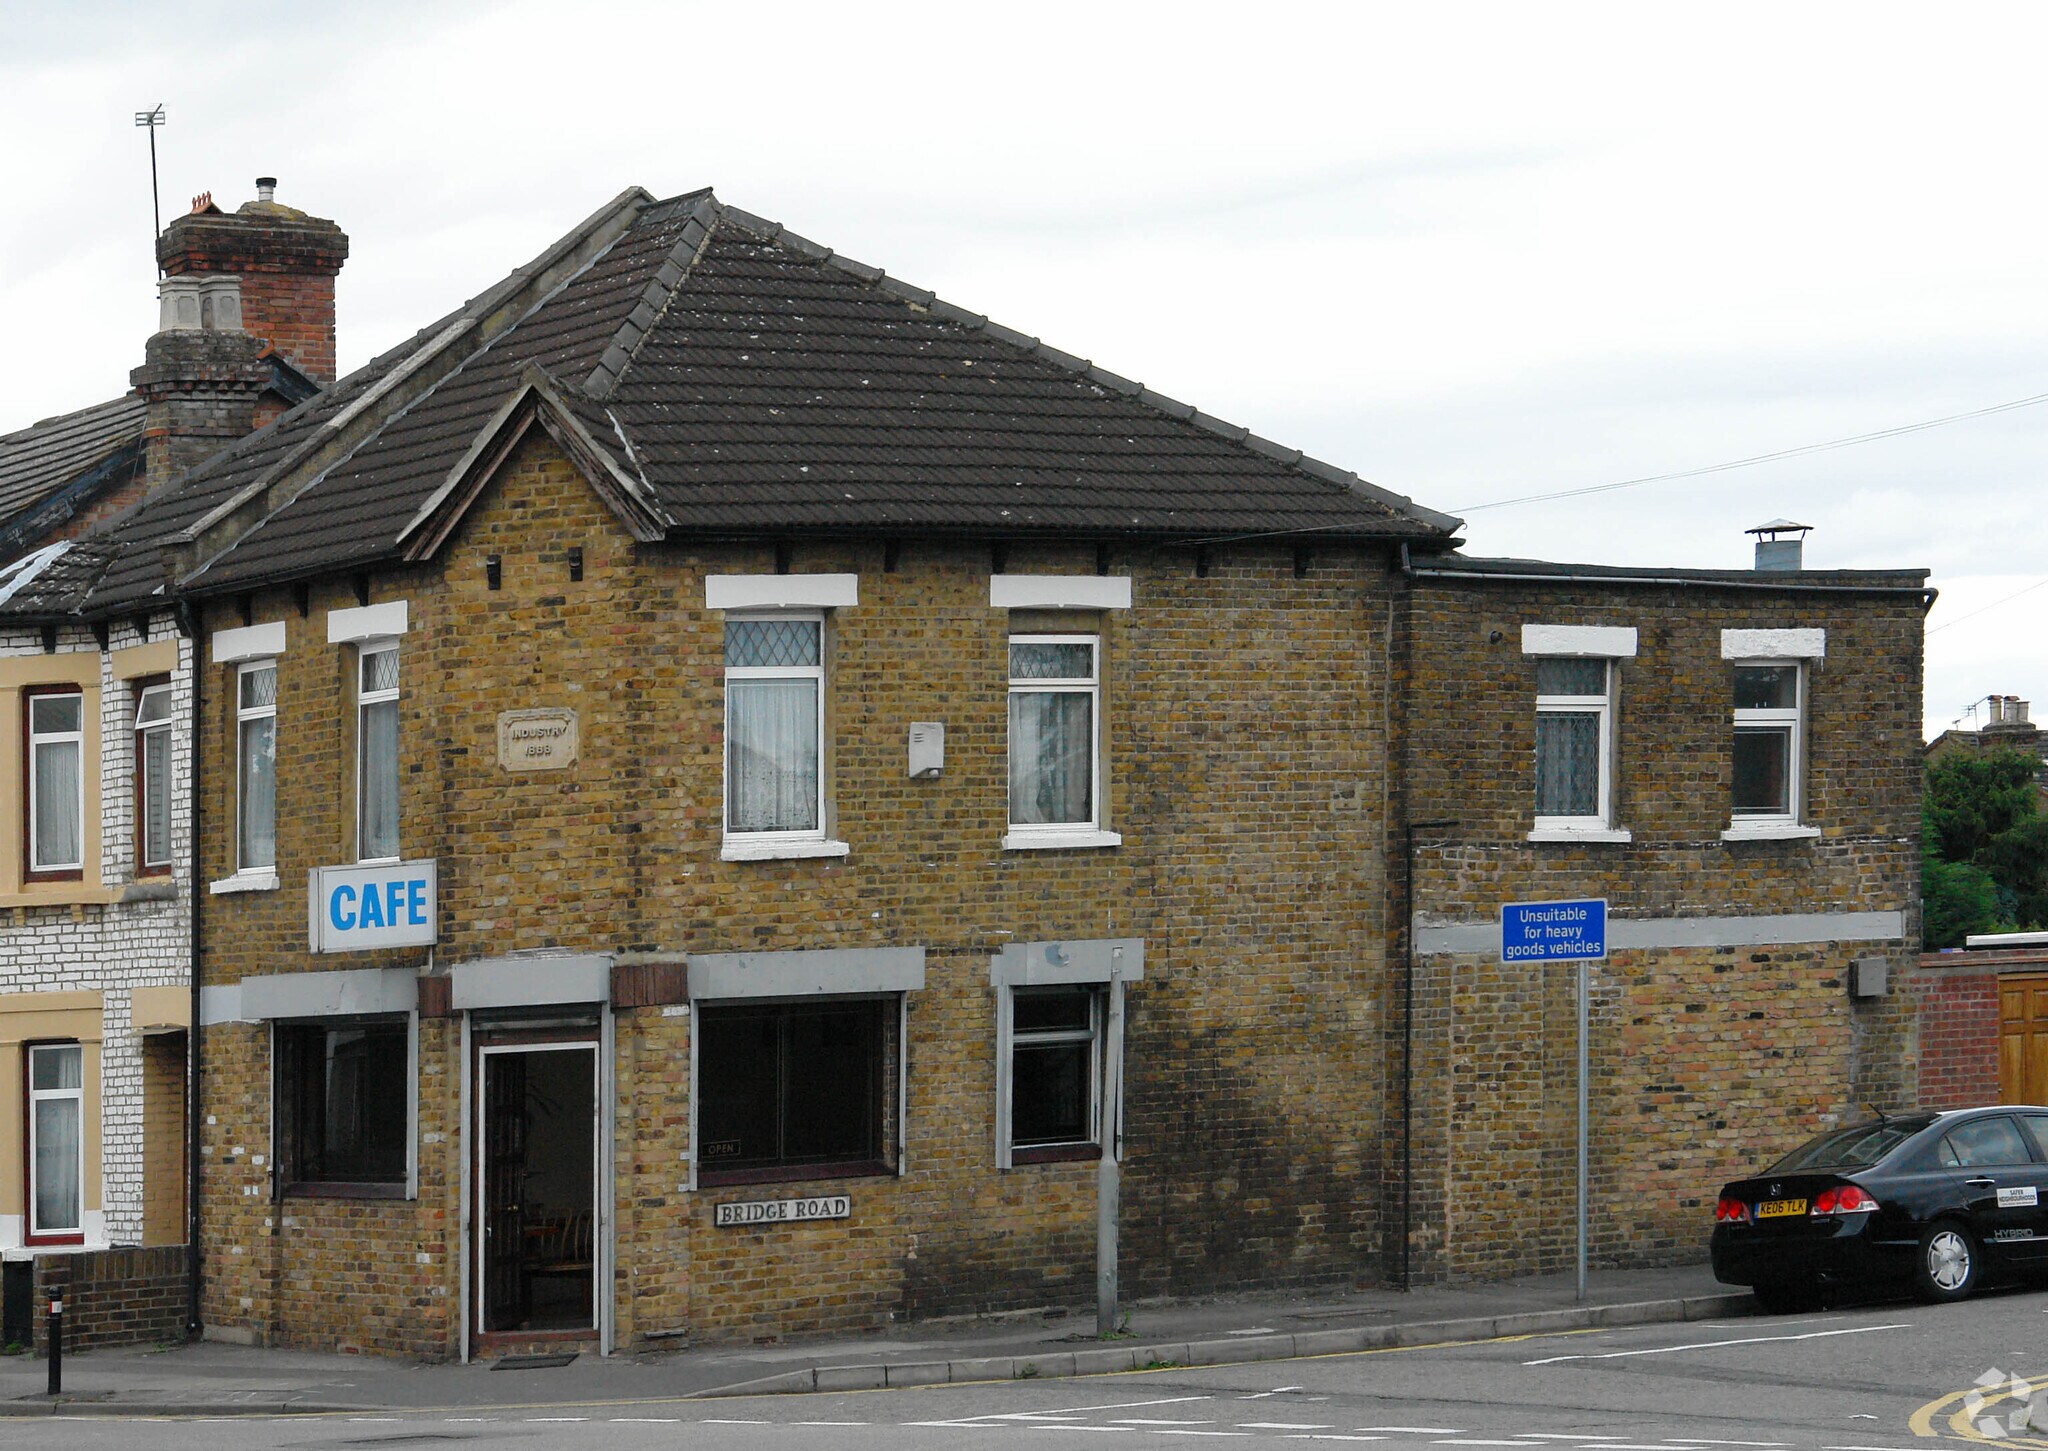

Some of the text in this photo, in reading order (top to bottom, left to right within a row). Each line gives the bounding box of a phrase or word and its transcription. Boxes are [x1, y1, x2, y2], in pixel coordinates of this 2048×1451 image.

[512, 725, 568, 741] INDUSTRY
[329, 879, 428, 932] CAFE
[1520, 906, 1587, 923] Unsuitable
[1523, 925, 1583, 940] for heavy
[1506, 939, 1601, 960] goods vehicles
[708, 1143, 734, 1155] OPEN
[721, 1198, 847, 1223] BRIDGE ROAD
[1760, 1198, 1804, 1215] KE06 TLK
[1993, 1228, 2034, 1239] HYBRID
